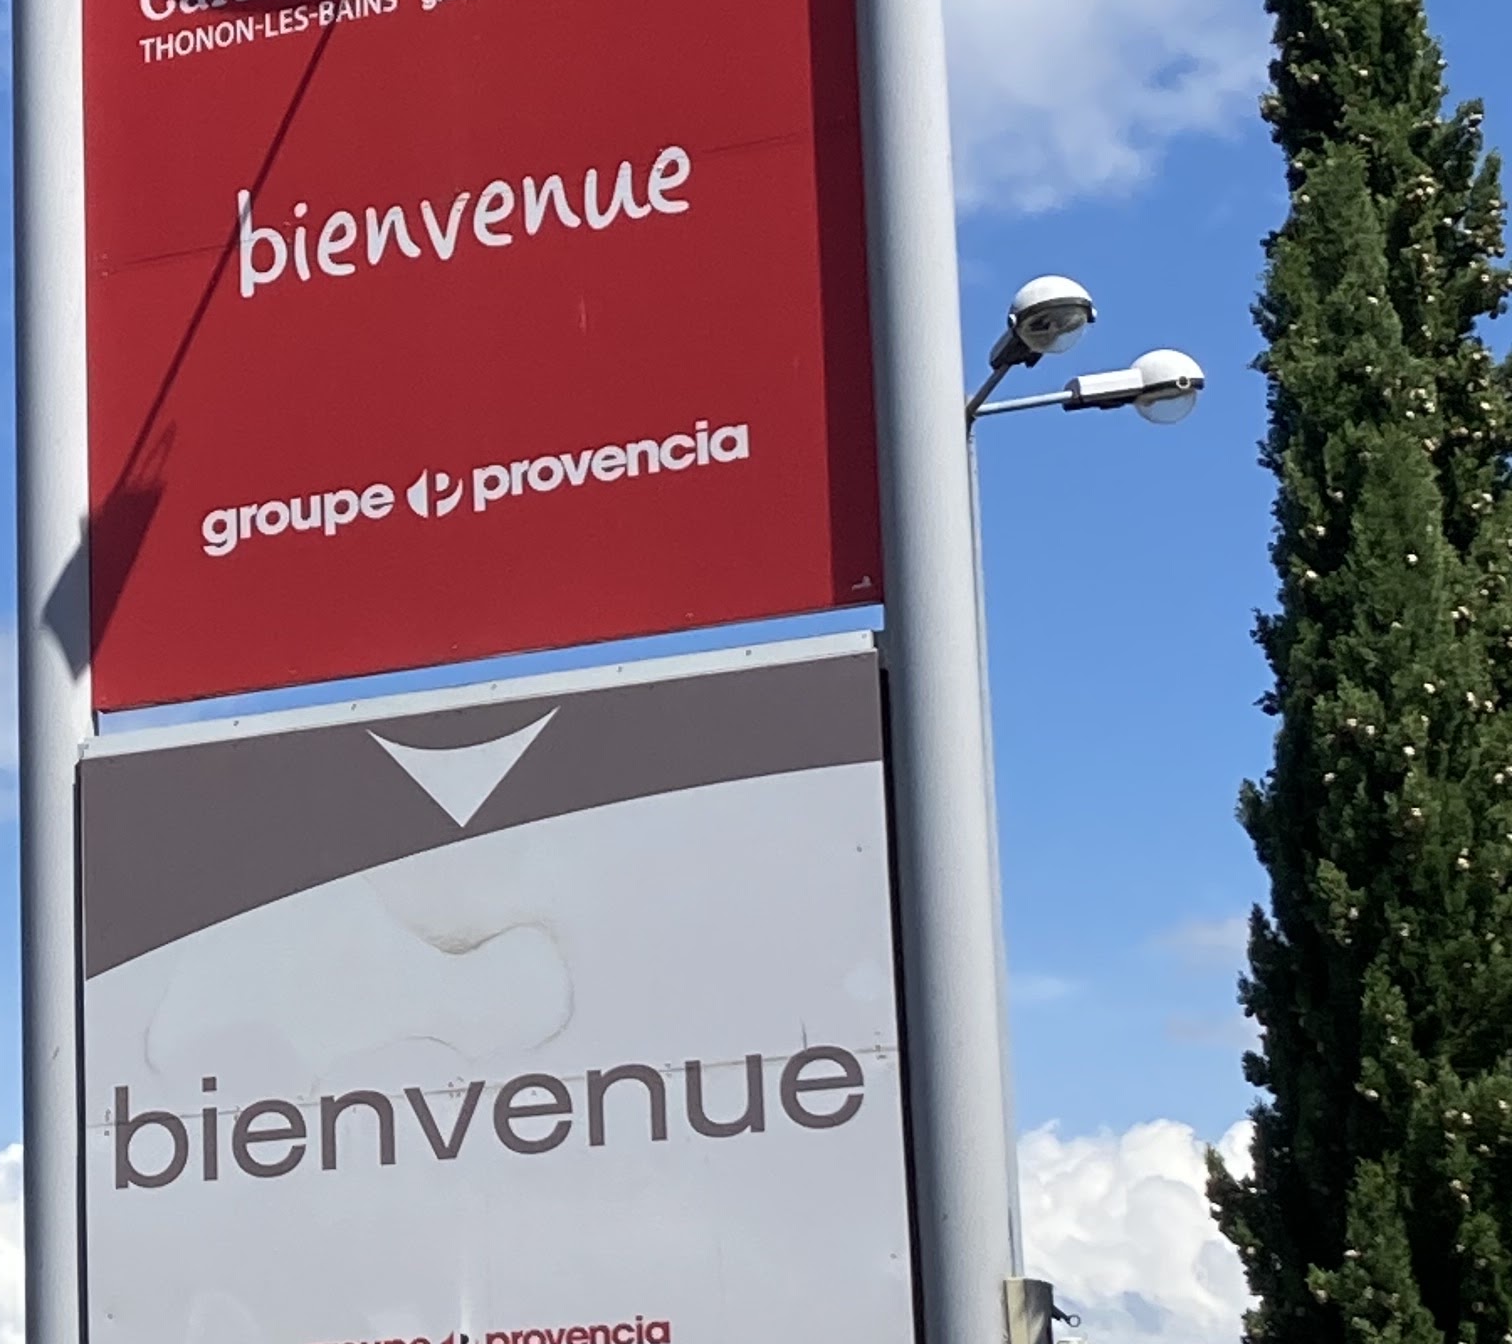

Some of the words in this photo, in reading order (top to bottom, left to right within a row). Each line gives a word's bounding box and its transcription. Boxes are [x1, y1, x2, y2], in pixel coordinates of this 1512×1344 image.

[237, 145, 692, 298] bienvenue
[201, 483, 395, 557] groupe
[473, 420, 750, 512] provencia
[114, 1044, 865, 1191] bienvenue
